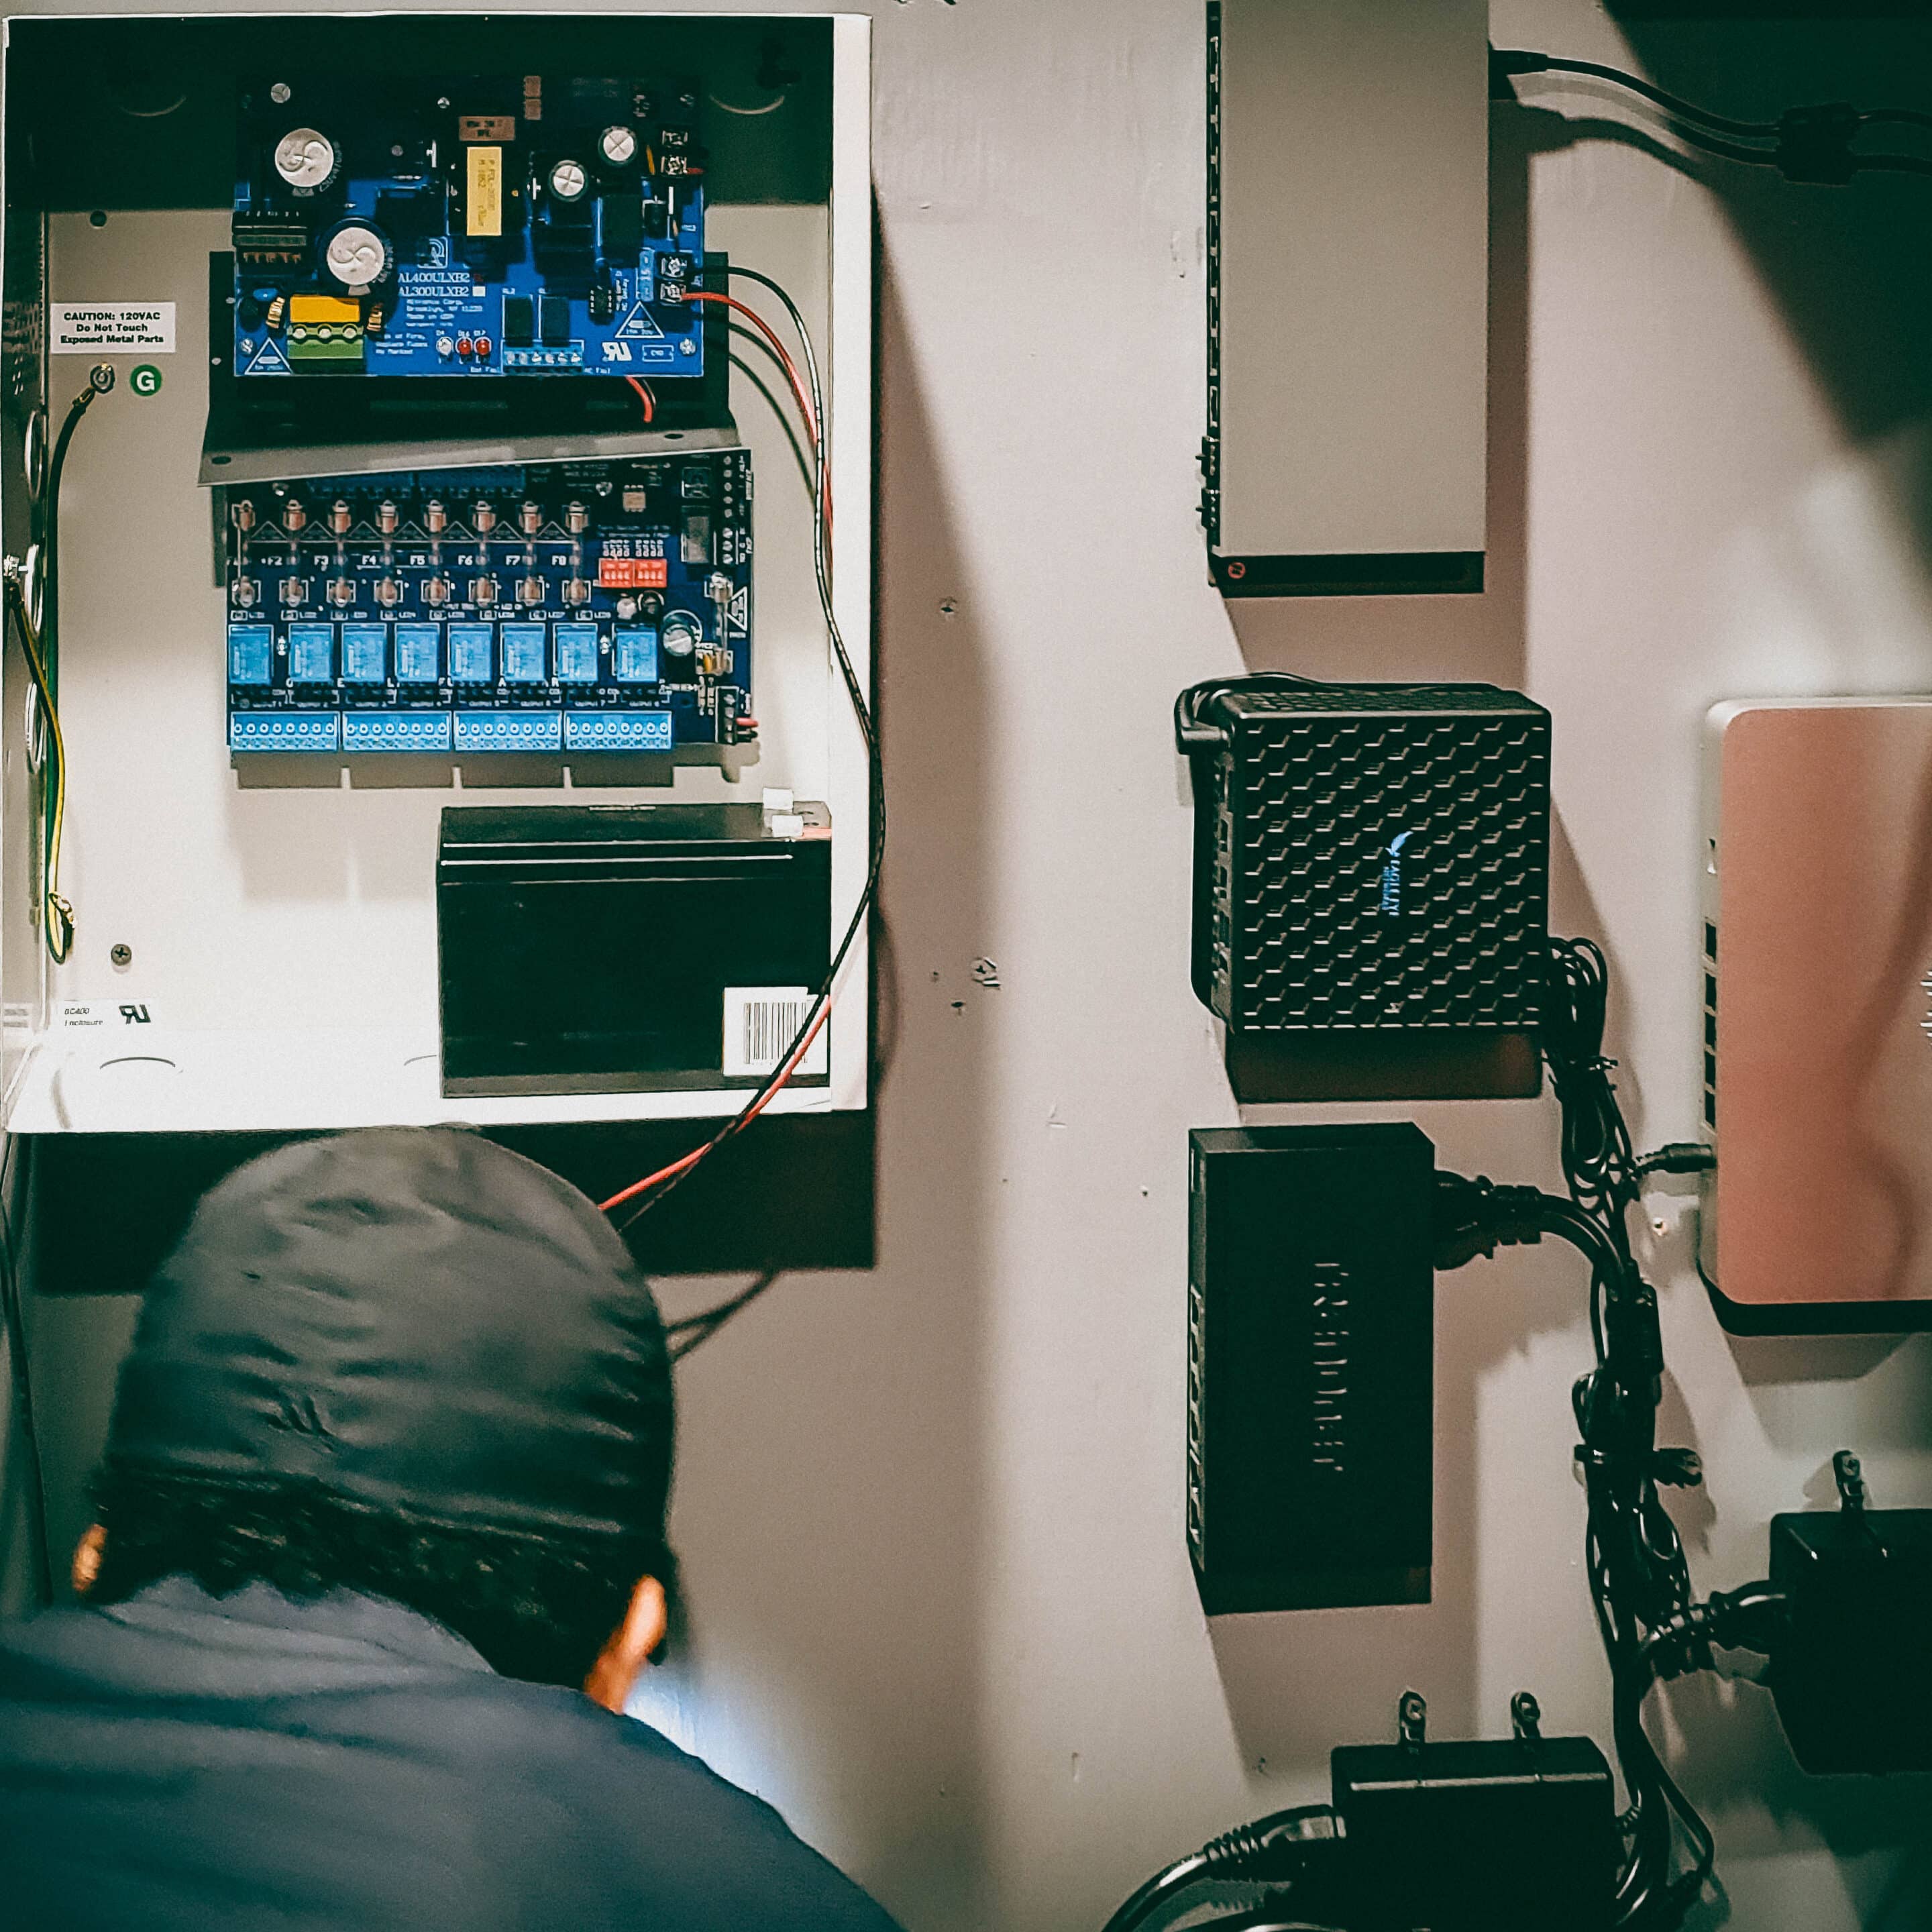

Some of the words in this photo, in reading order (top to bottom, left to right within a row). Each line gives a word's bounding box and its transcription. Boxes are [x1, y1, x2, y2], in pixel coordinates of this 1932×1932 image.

[398, 272, 470, 283] AL400ULXB2
[398, 286, 470, 297] AL300ULXB2
[64, 313, 115, 321] CAUTION:
[120, 312, 161, 321] 120VAC
[60, 335, 103, 345] Exposed
[107, 335, 134, 343] Metal
[138, 335, 164, 343] Parts
[136, 372, 156, 392] G
[268, 555, 282, 566] F2
[314, 555, 329, 566] F3
[362, 555, 376, 566] F4
[410, 555, 425, 566] F5
[458, 555, 473, 566] F6
[505, 555, 521, 566] F7
